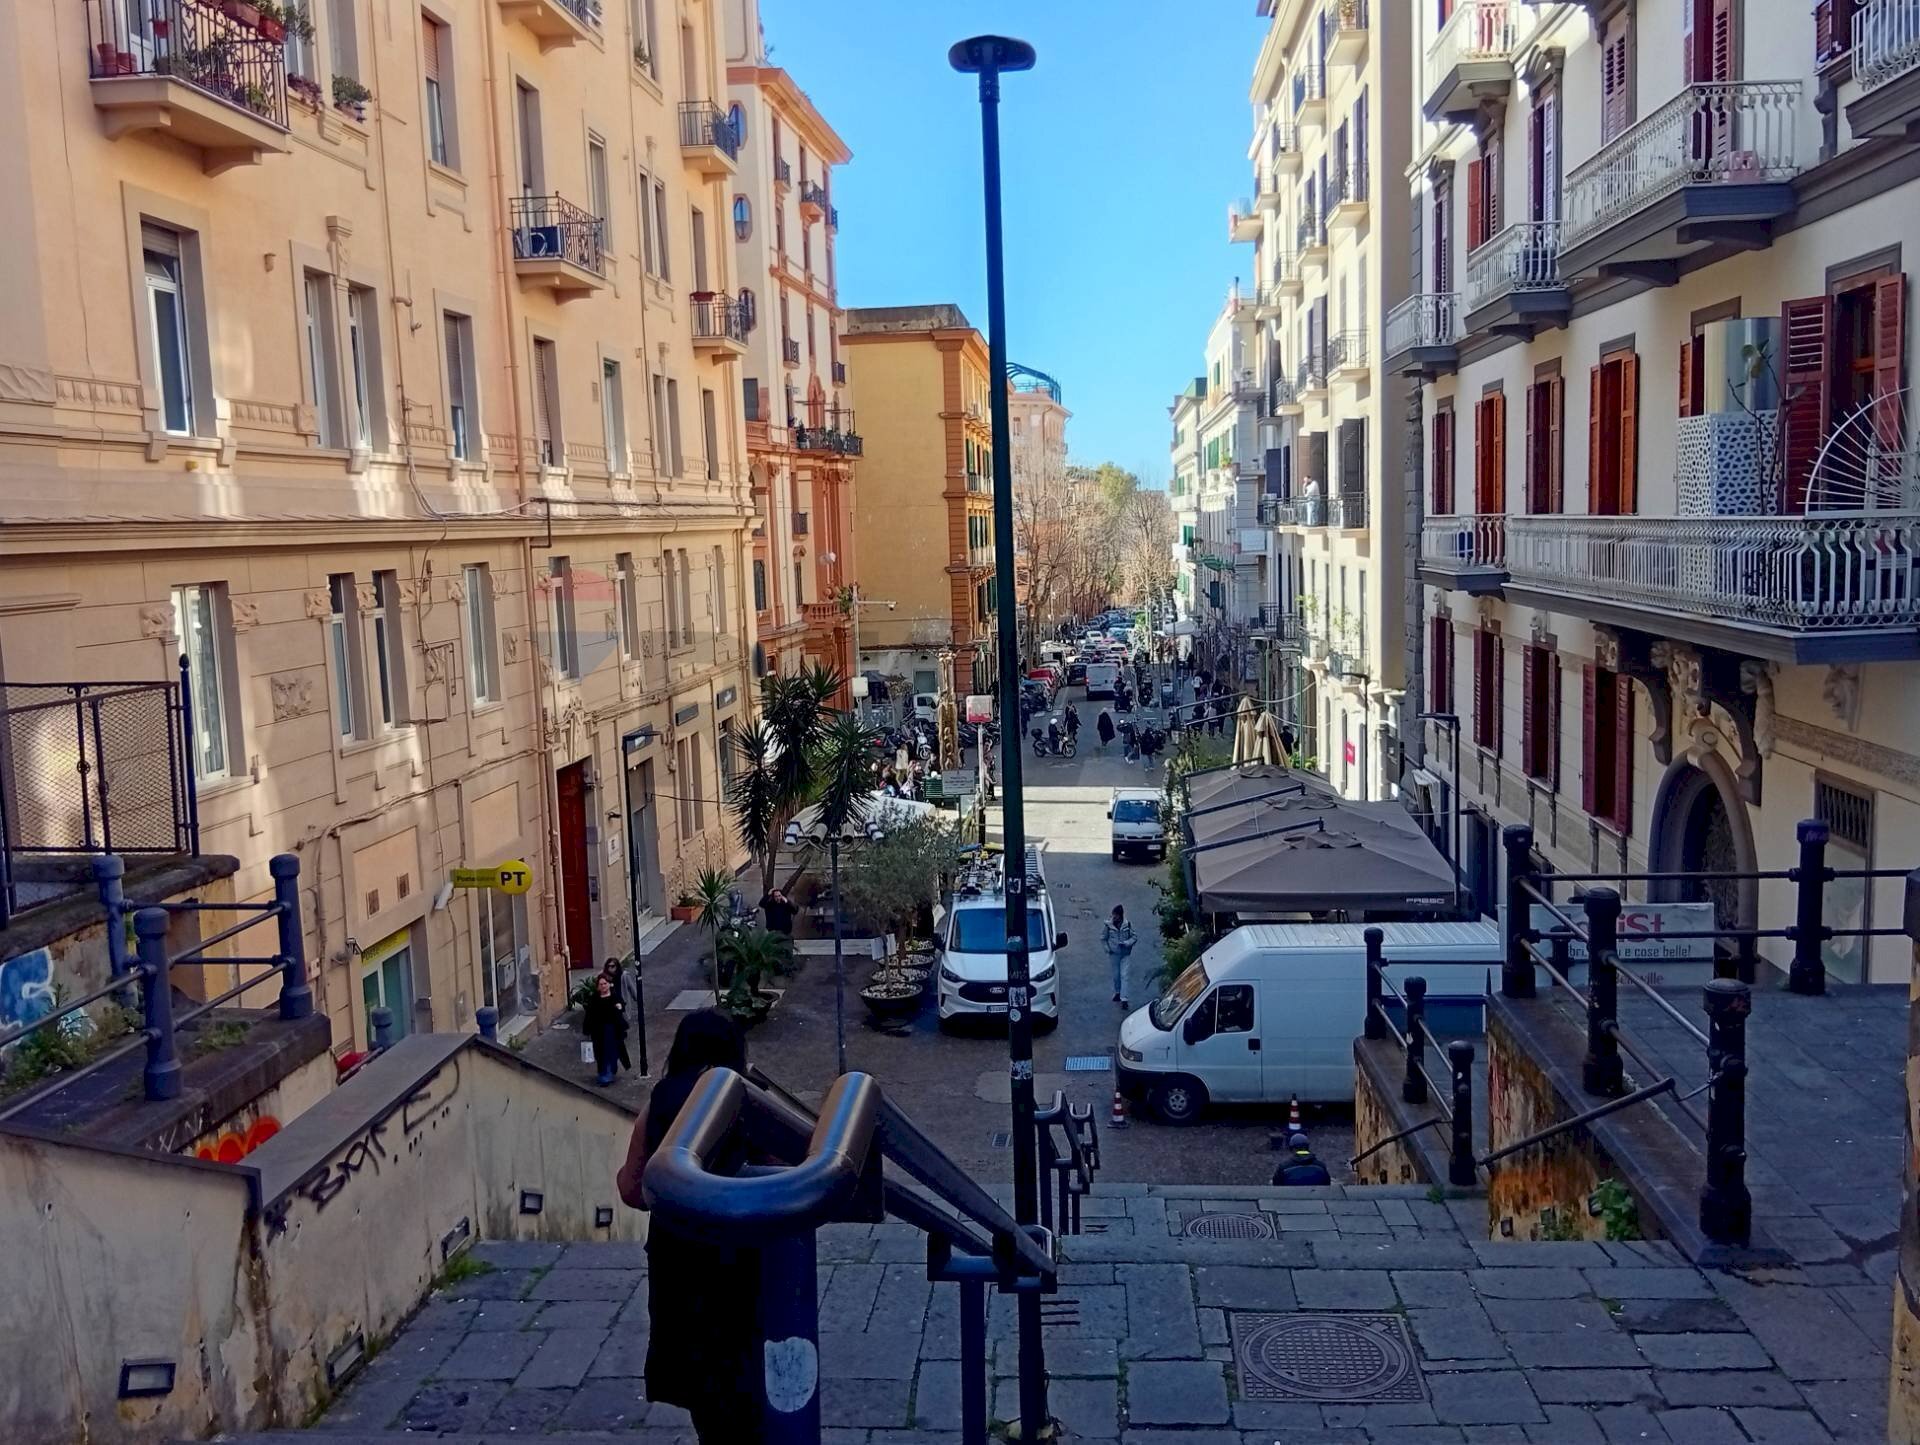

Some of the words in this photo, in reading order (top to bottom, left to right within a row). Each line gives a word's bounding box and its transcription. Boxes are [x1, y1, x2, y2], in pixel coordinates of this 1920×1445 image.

[500, 871, 526, 887] PT
[1624, 948, 1631, 957] e
[1634, 948, 1659, 957] cose
[1663, 944, 1691, 957] belle!
